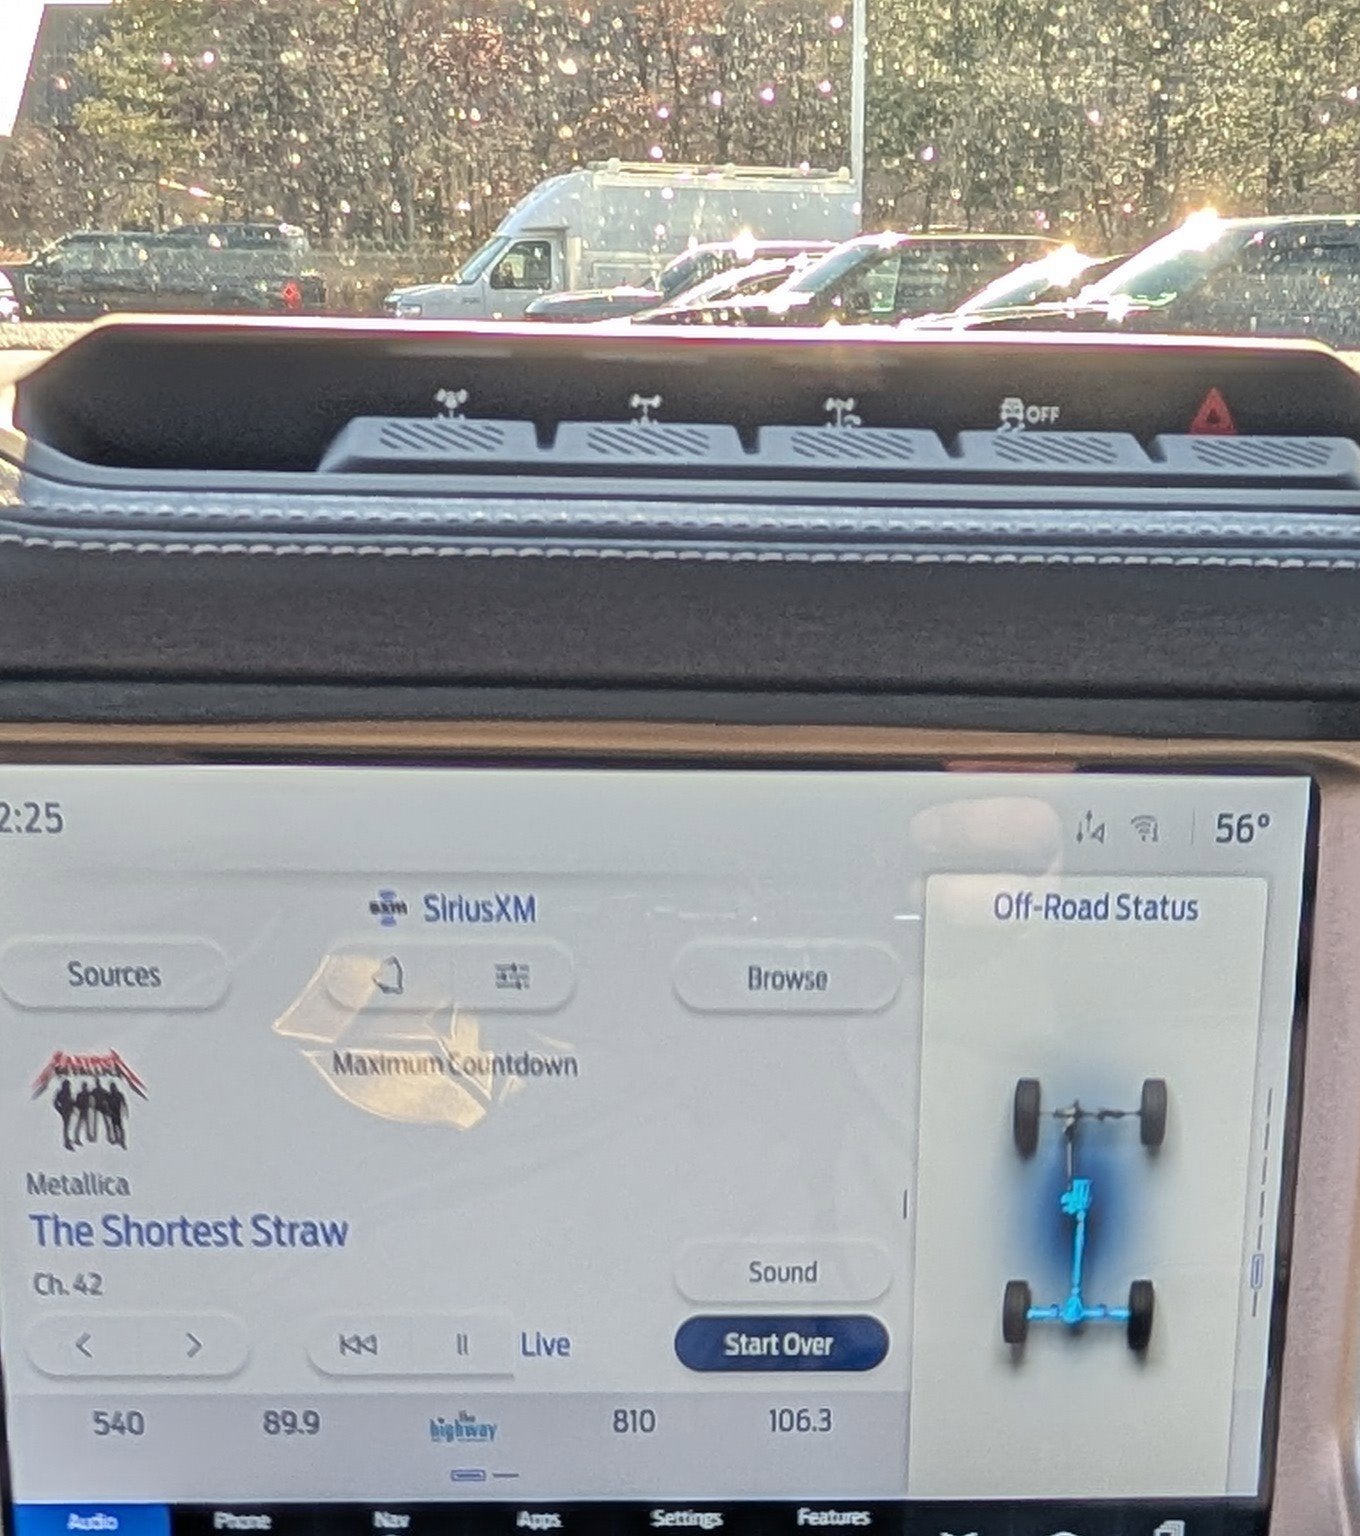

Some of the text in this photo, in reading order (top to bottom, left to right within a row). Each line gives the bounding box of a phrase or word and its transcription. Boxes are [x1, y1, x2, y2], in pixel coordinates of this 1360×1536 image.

[1026, 406, 1060, 422] OFF
[1215, 812, 1270, 844] 56°
[423, 893, 536, 924] SiriusXM
[994, 893, 1199, 922] Off-Road Status
[68, 960, 162, 988] Sources
[747, 966, 829, 991] Browse
[333, 1051, 579, 1078] Maximum Countdown
[26, 1171, 131, 1196] Metallica
[29, 1212, 349, 1249] The Shortest Straw
[33, 1272, 103, 1297] Ch. 42
[748, 1260, 818, 1284] Sound
[521, 1331, 572, 1358] Live
[724, 1331, 834, 1357] Start Over
[93, 1411, 145, 1437] 540
[263, 1410, 321, 1435] 89.9
[429, 1418, 498, 1442] highway
[612, 1409, 656, 1433] 810
[768, 1408, 832, 1433] 106.3
[67, 1512, 119, 1531] Audio
[213, 1511, 272, 1531] Phone
[374, 1511, 410, 1530] Nav
[517, 1511, 562, 1532] Apps
[650, 1509, 724, 1530] Settings
[797, 1508, 871, 1527] Features
